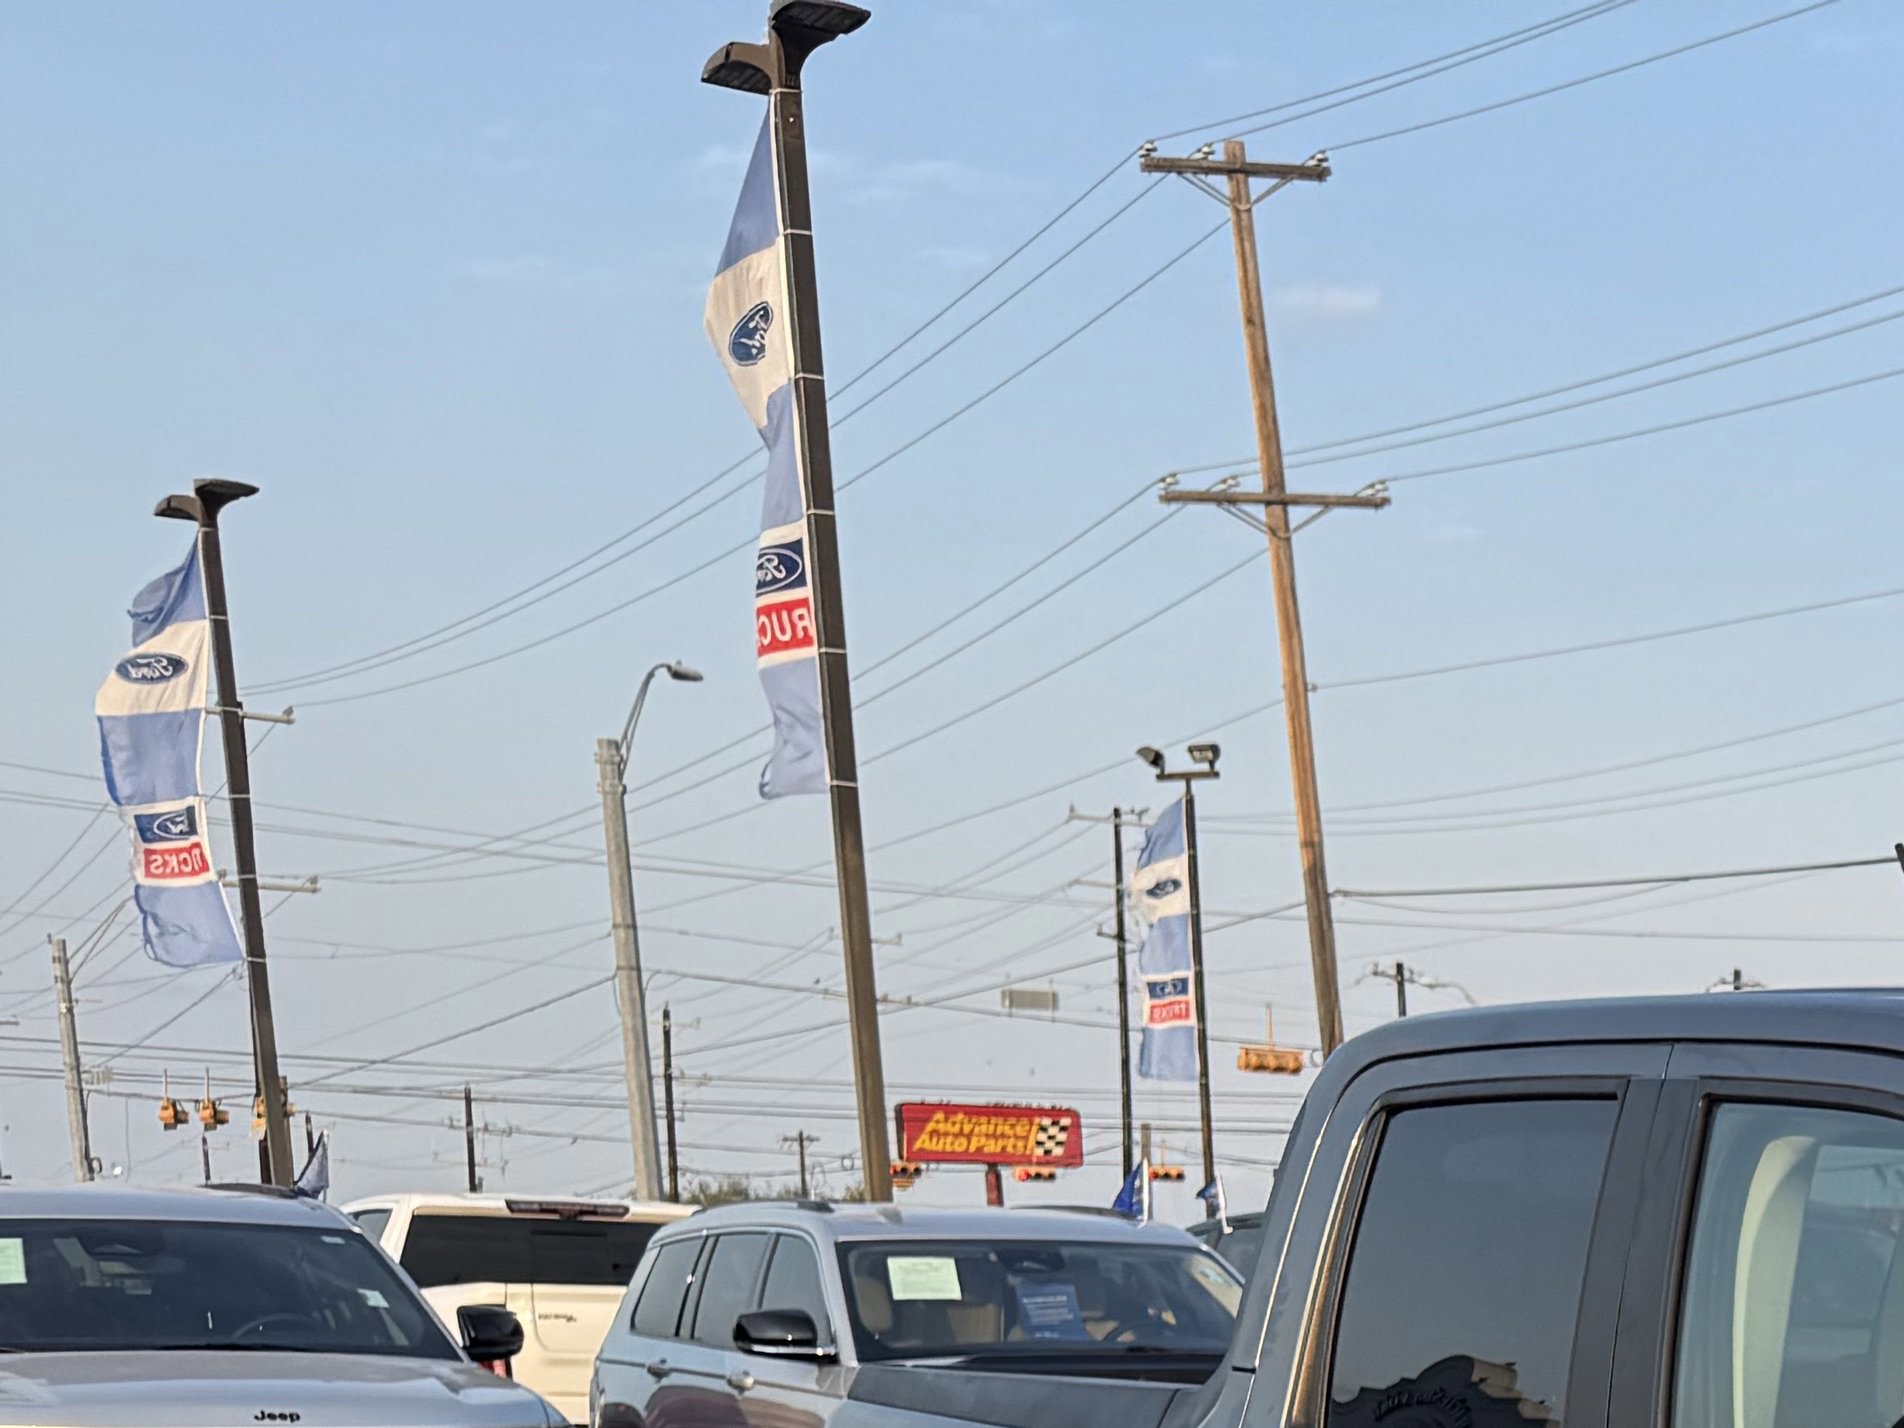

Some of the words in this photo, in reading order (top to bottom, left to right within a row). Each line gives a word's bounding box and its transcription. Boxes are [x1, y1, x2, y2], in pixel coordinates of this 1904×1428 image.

[926, 1110, 1031, 1137] Advance
[913, 1132, 968, 1153] Auto
[968, 1135, 1027, 1155] Parts
[254, 1410, 301, 1423] Jeep
